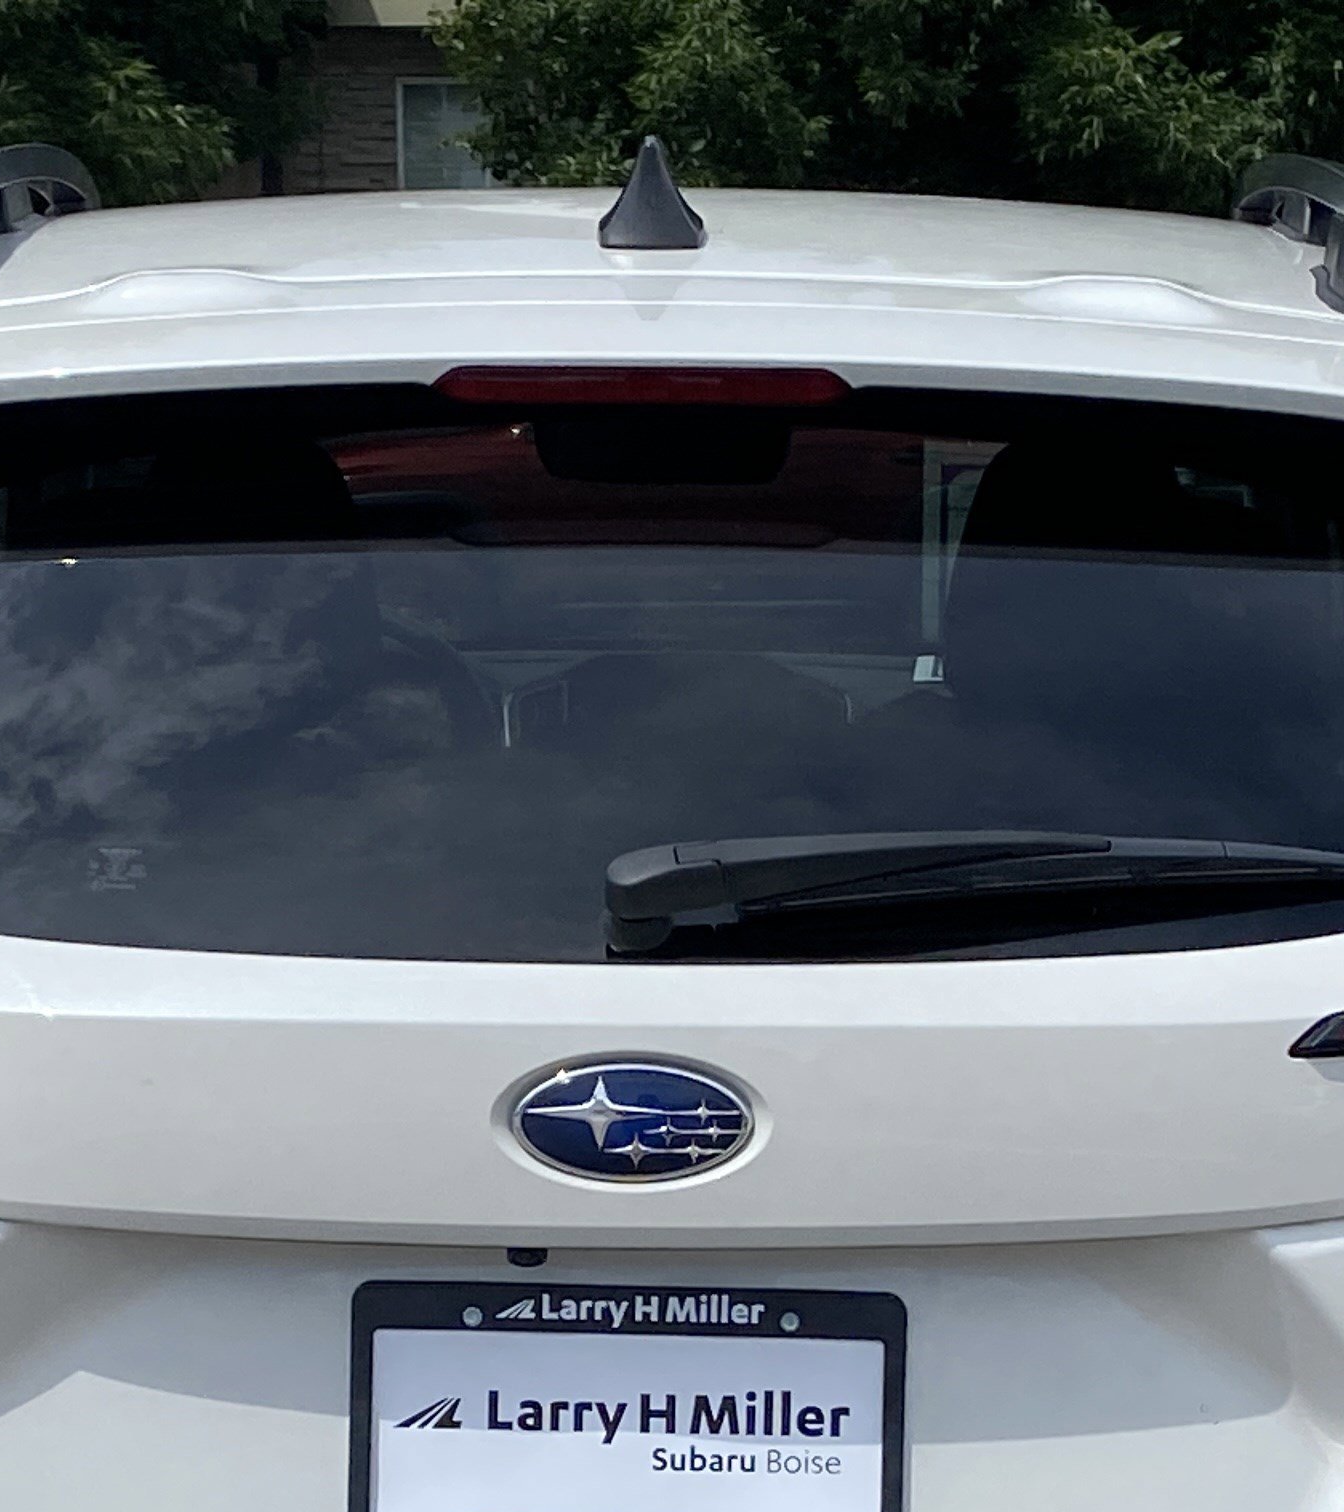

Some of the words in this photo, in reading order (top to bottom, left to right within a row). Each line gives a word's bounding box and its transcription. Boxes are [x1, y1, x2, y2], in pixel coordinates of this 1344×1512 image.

[541, 1294, 630, 1328] Larry
[635, 1296, 659, 1323] H
[665, 1295, 766, 1325] Miller
[487, 1390, 628, 1444] Larry
[639, 1393, 677, 1434] H
[689, 1390, 851, 1438] Miller
[651, 1447, 757, 1474] Subaru
[766, 1448, 843, 1476] Boise
